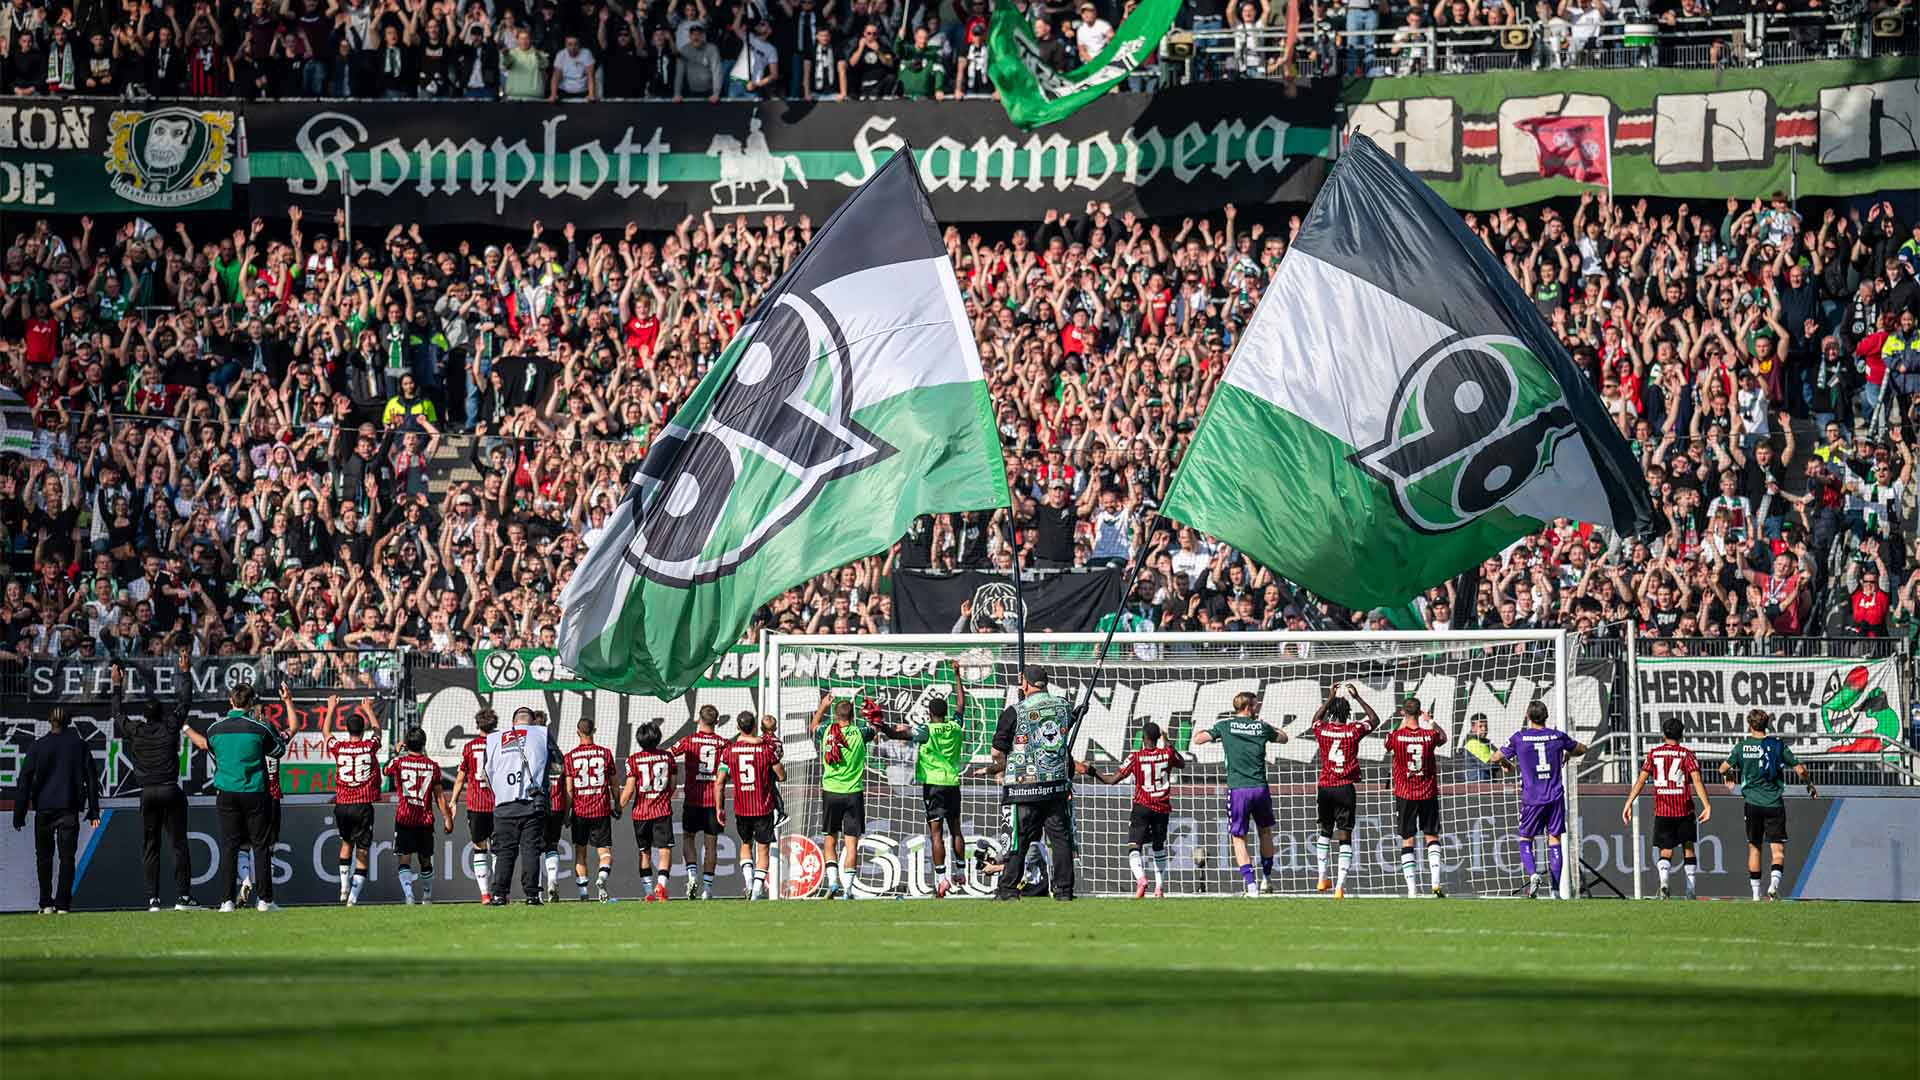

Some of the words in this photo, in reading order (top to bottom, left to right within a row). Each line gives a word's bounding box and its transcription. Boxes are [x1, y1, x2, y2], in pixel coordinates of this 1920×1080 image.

[287, 111, 671, 215] Komplott
[834, 114, 1293, 194] Hannovera
[33, 666, 219, 695] SEHLEM
[490, 654, 520, 686] 96
[1640, 669, 1723, 705] HERRI
[1731, 670, 1816, 706] CREW
[700, 745, 716, 773] 9
[1328, 740, 1345, 766] 4
[1406, 744, 1423, 771] 3
[1534, 742, 1551, 772] 1
[338, 754, 371, 783] 26
[573, 757, 604, 788] 33
[638, 761, 669, 792] 18
[739, 754, 755, 783] 5
[1141, 762, 1170, 792] 15
[1653, 757, 1686, 788] 14
[401, 769, 433, 800] 27
